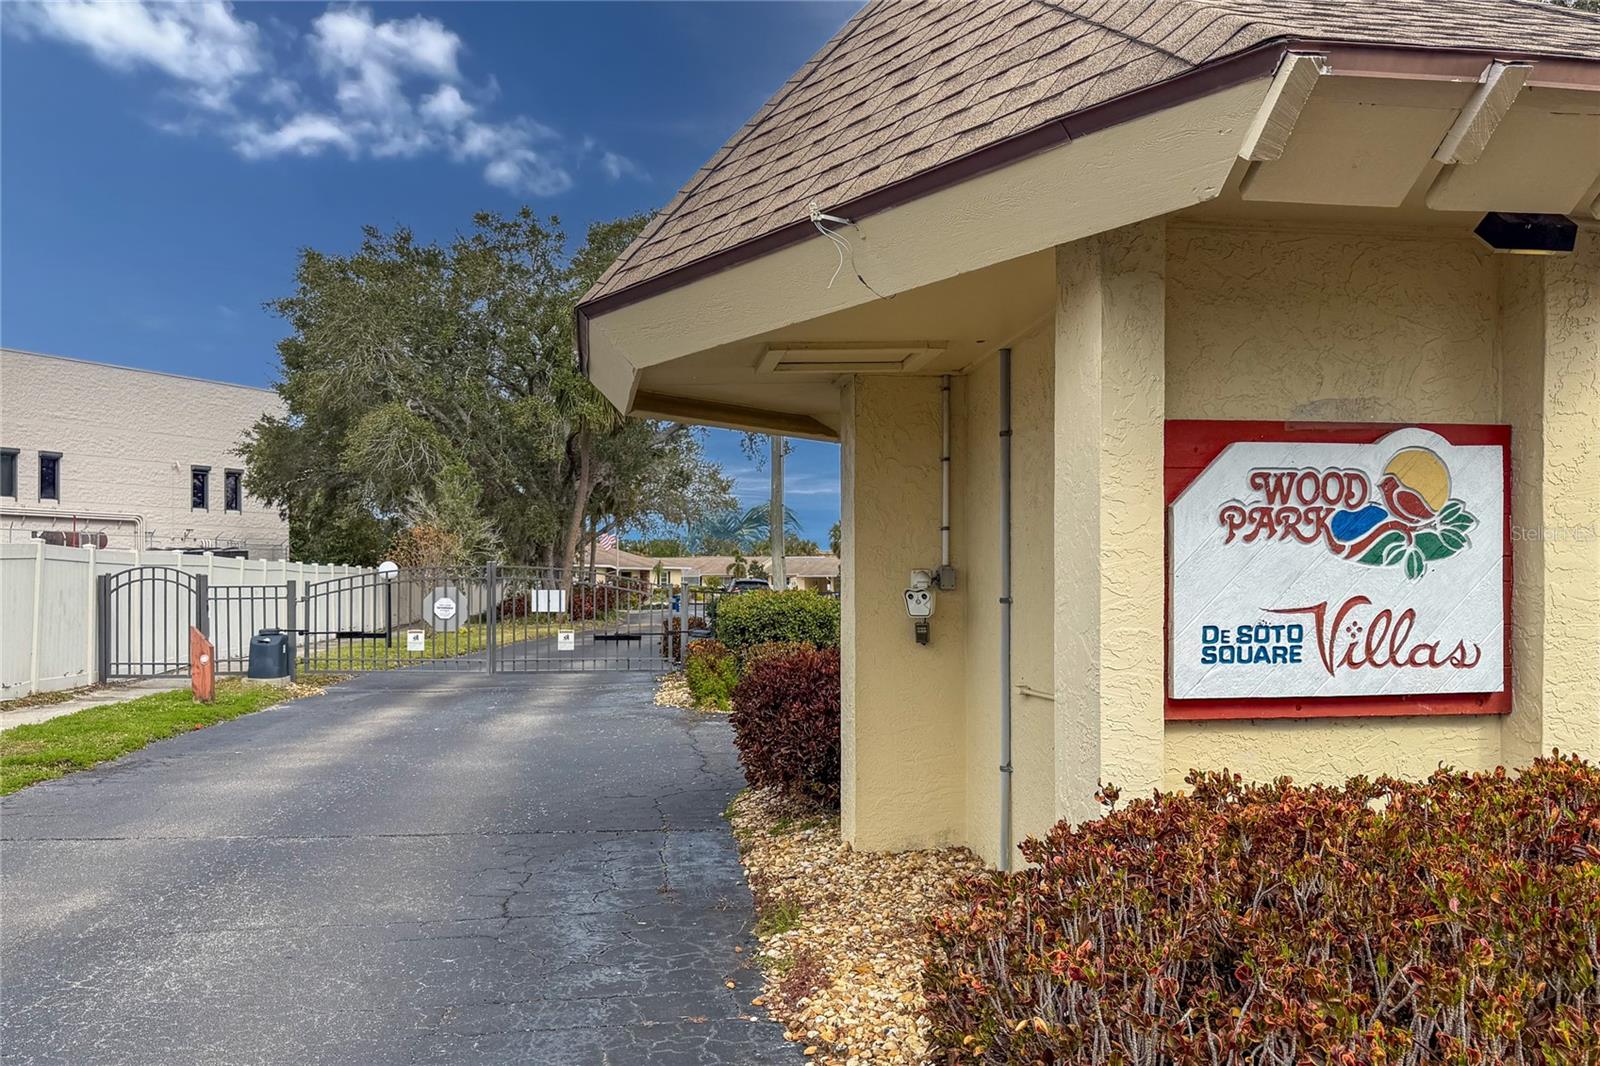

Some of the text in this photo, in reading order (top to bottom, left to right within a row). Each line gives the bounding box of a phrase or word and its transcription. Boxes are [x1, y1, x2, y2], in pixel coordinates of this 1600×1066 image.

[1250, 471, 1368, 510] WOOD
[1219, 505, 1346, 554] PARK
[1236, 624, 1303, 644] SOTO
[1259, 595, 1481, 677] Villas
[1201, 645, 1303, 664] SQUARE
